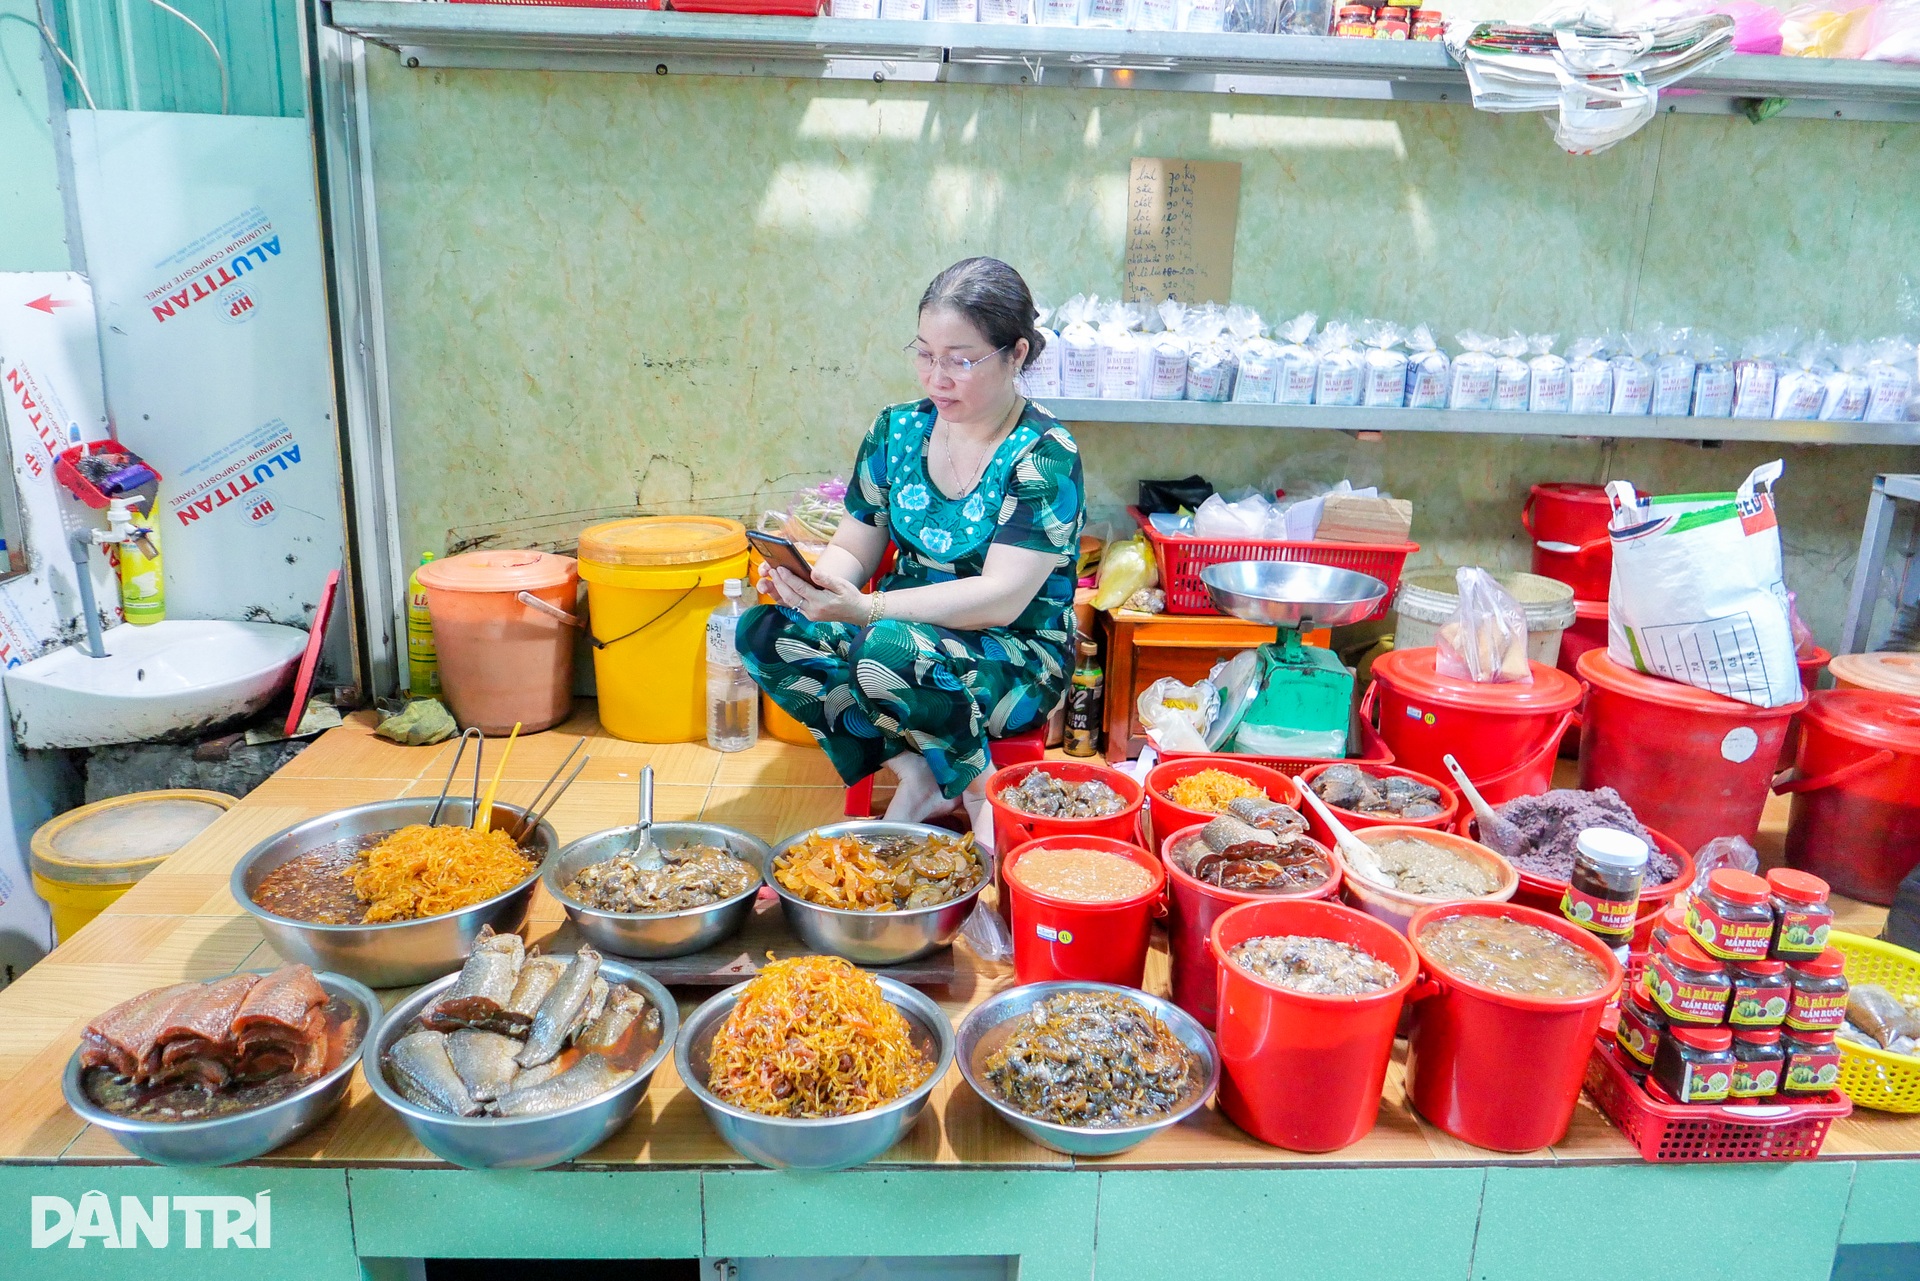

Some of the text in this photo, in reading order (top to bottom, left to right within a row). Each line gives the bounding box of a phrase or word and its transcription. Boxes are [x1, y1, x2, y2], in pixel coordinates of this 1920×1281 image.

[225, 222, 272, 254] ALUMINUM
[151, 235, 282, 323] ALUTITAN
[173, 251, 225, 285] COMPOSITE
[144, 282, 173, 301] PANEL
[230, 295, 254, 317] HP
[19, 359, 38, 392] PANEL
[25, 453, 43, 477] HP
[168, 432, 293, 507] ALUMINUM COMPOSITE PANEL
[176, 444, 302, 527] ALUTITAN
[251, 500, 275, 521] HP
[1601, 914, 1620, 924] MẮM
[1724, 935, 1769, 948] MẮM RUỐC
[1680, 998, 1726, 1011] MẮM RUỐC
[1799, 1006, 1844, 1019] MẮM RUỐC
